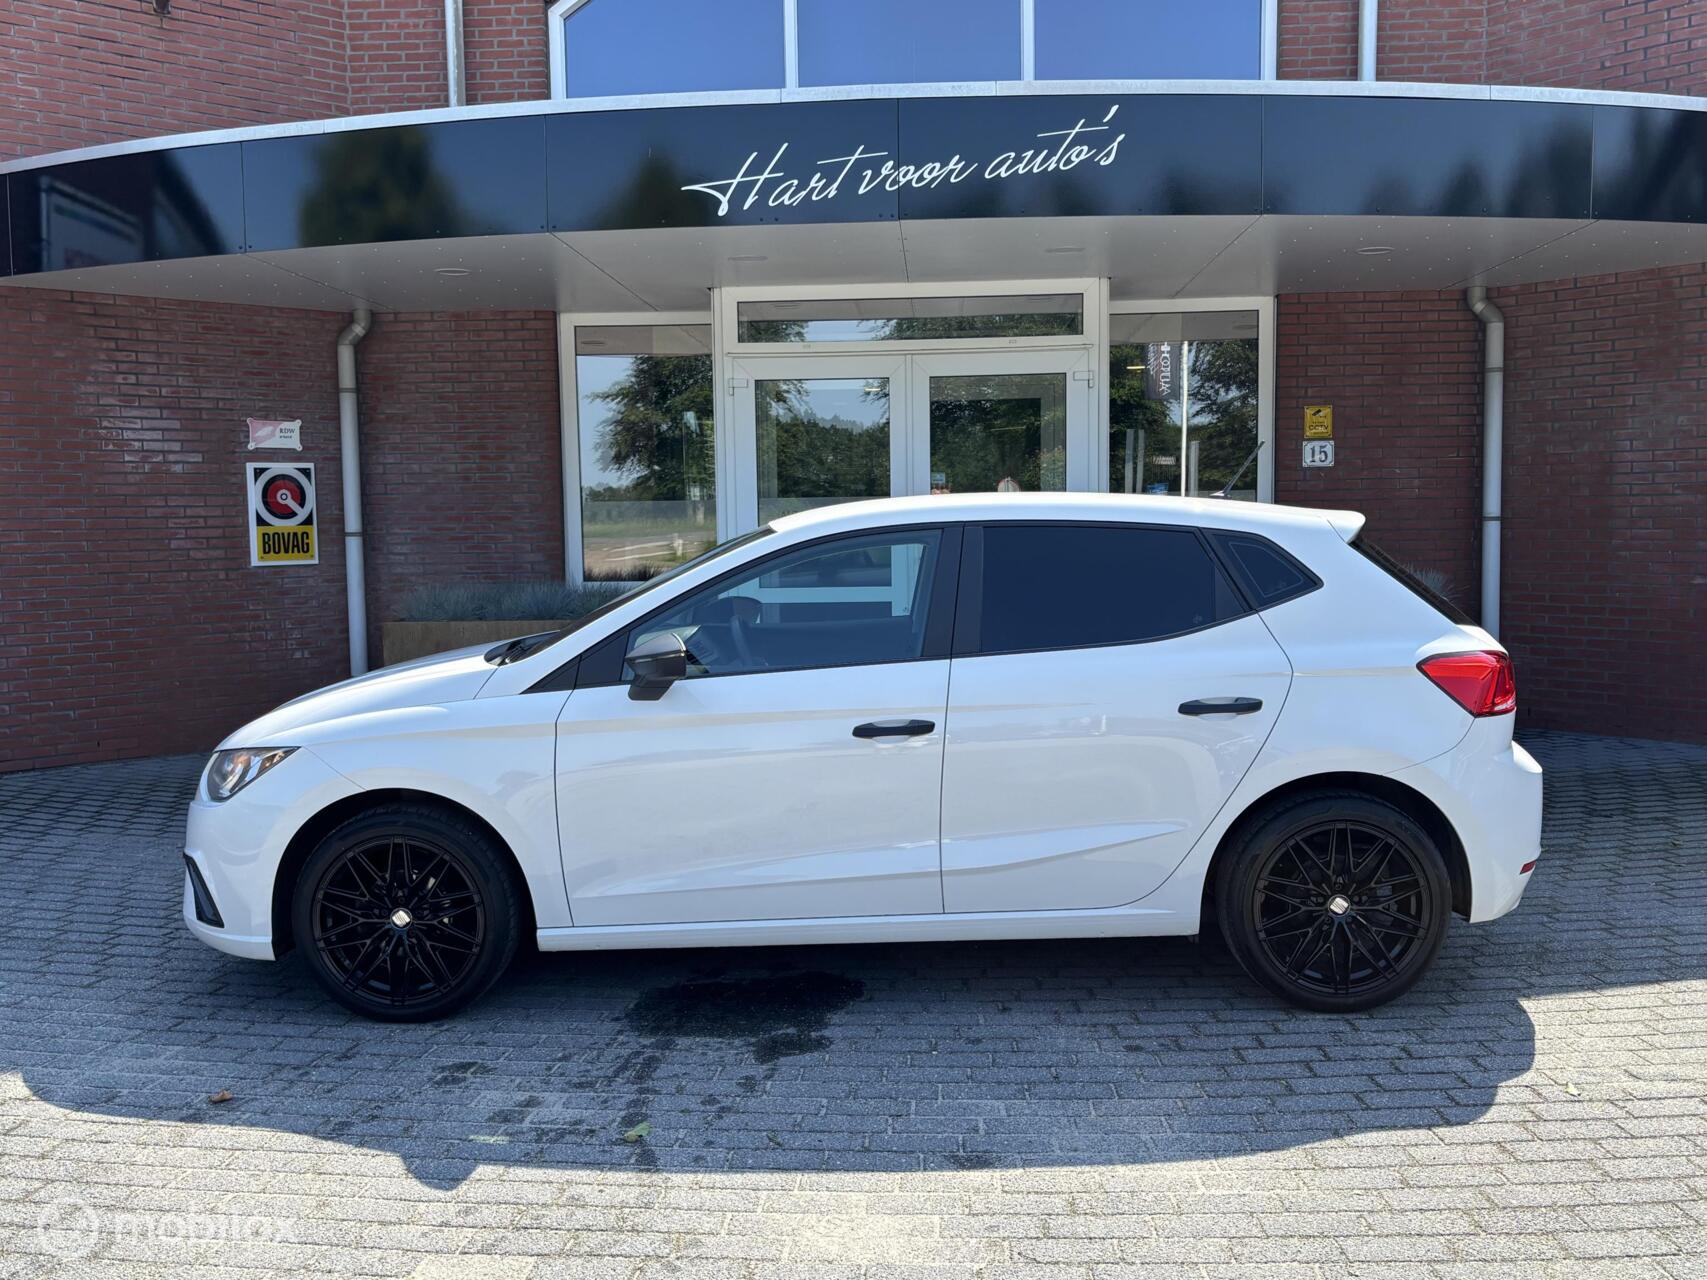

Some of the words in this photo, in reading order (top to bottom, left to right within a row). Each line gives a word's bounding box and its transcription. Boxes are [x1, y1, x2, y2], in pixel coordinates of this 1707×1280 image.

[681, 142, 888, 217] Hart
[857, 154, 978, 198] voor
[984, 104, 1127, 179] auto's
[1309, 444, 1329, 463] 15
[262, 531, 310, 555] BOVAG
